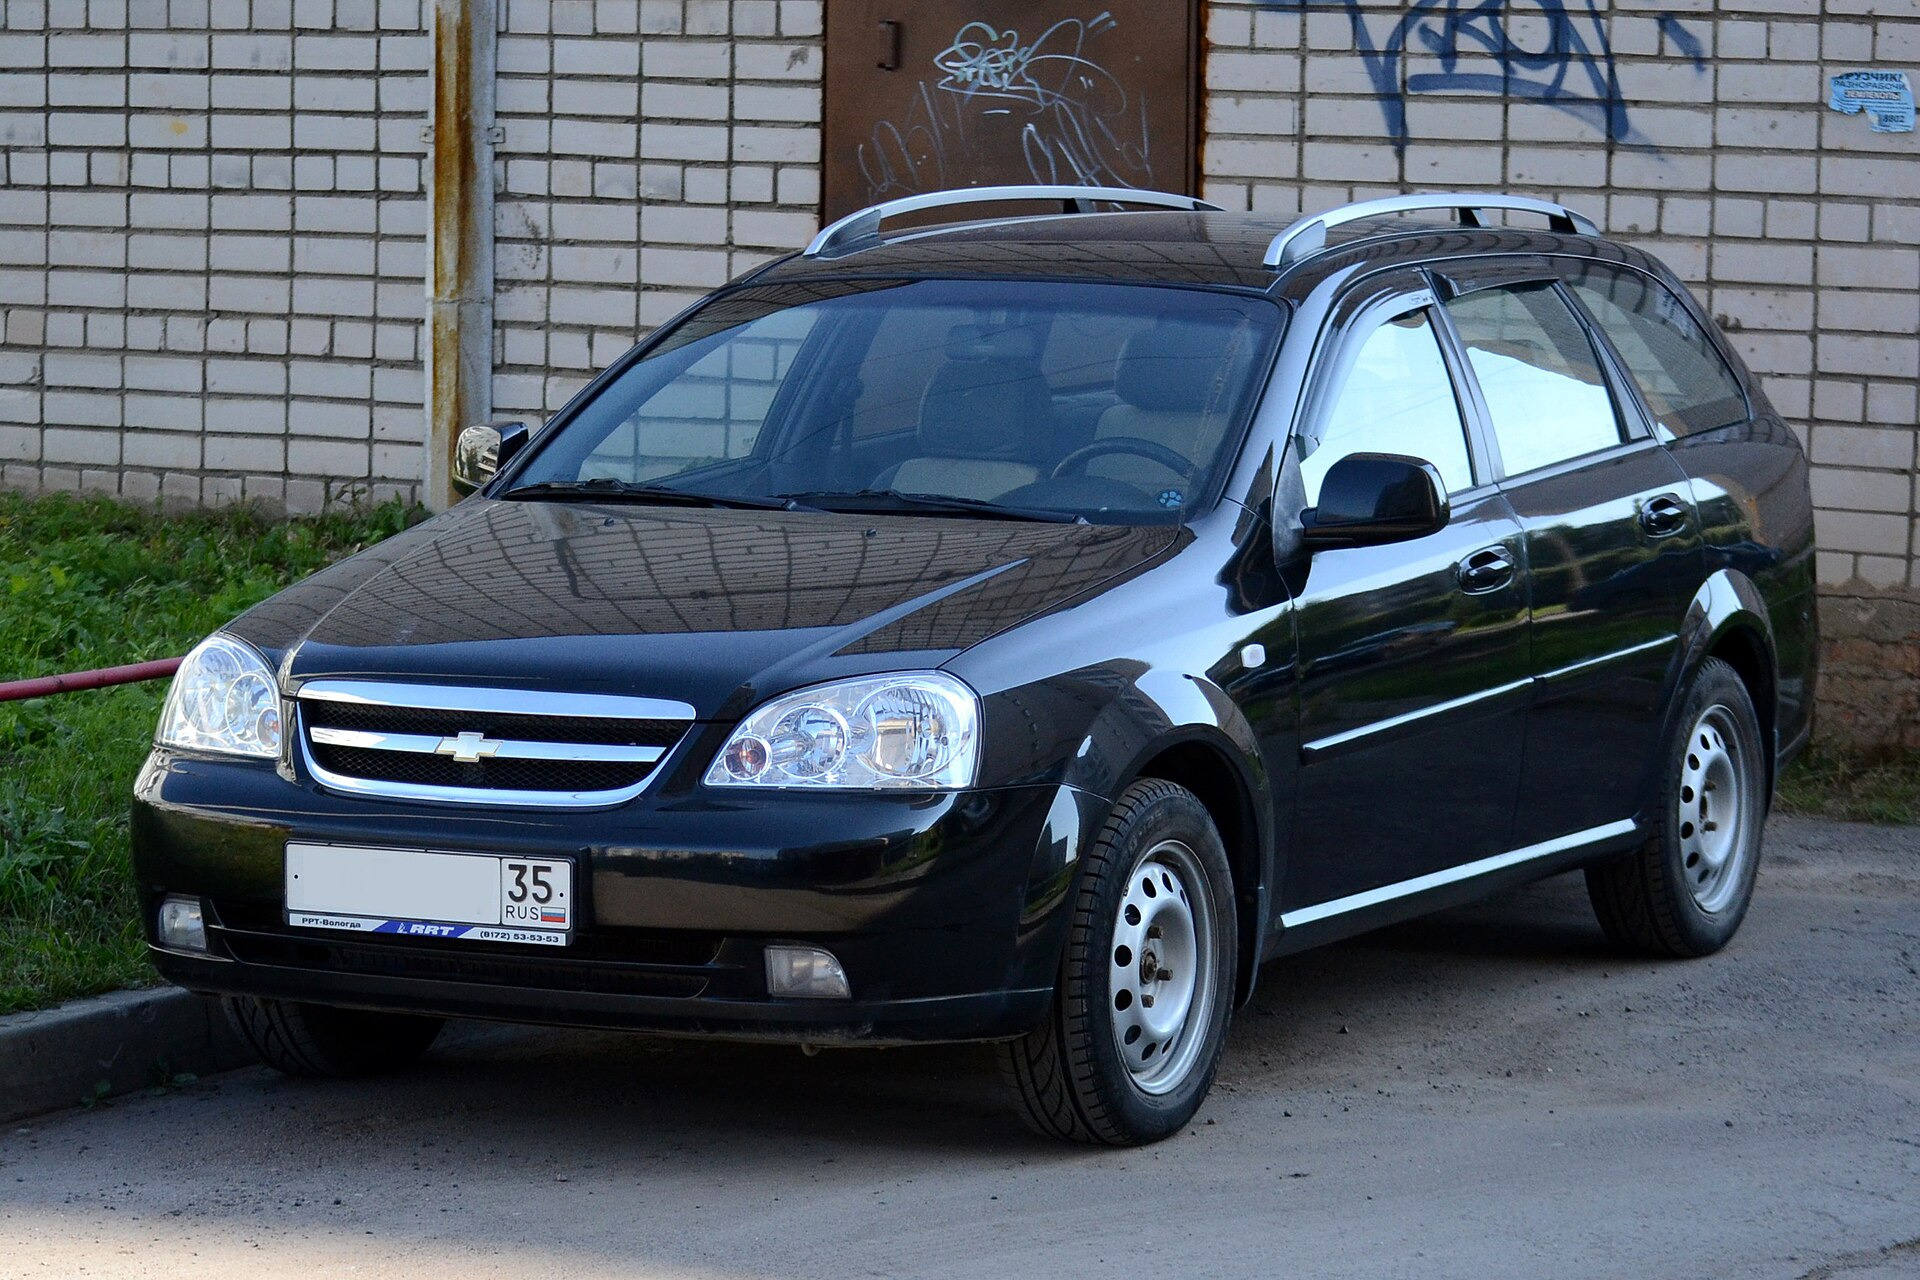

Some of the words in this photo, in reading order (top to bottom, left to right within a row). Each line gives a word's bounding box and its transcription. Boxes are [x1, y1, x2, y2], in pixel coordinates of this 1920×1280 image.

[508, 864, 552, 904] 35
[505, 905, 539, 920] RUS
[302, 917, 361, 928] РРТ-Вологда
[409, 924, 455, 936] RRT
[480, 931, 510, 941] (8172)
[513, 934, 559, 943] 53-53-53
